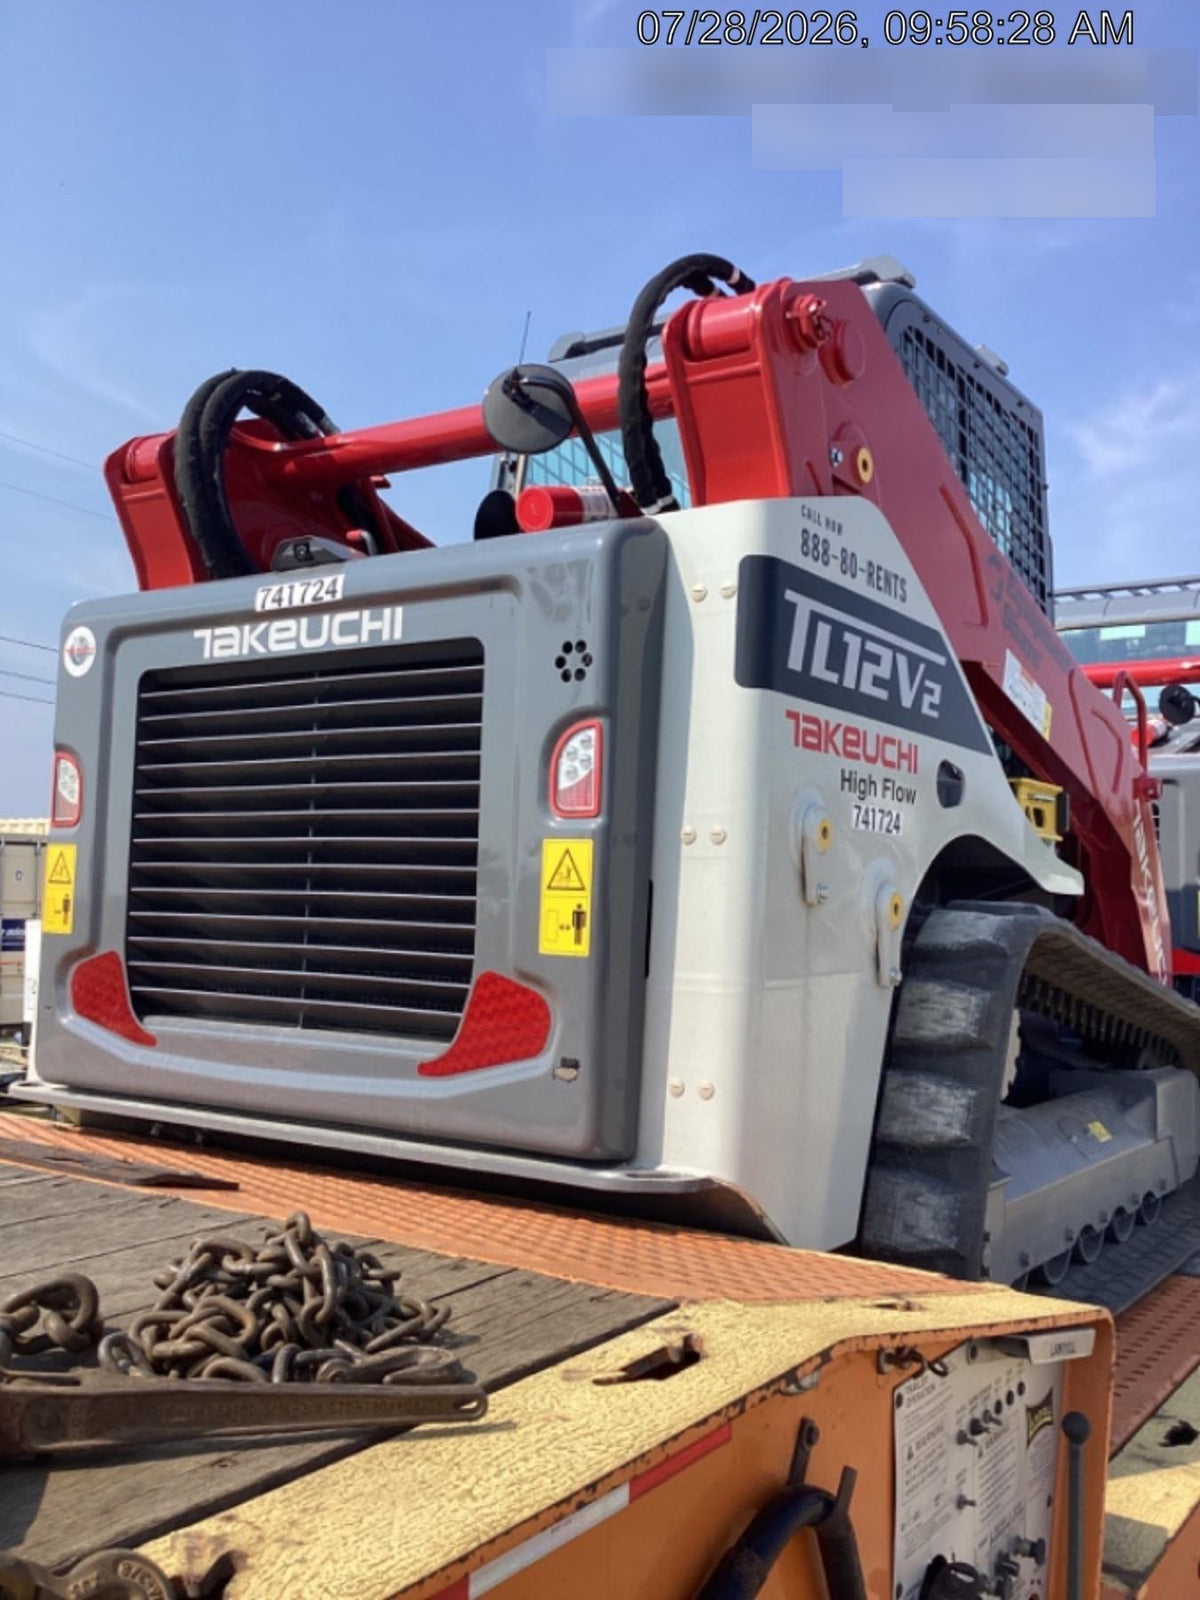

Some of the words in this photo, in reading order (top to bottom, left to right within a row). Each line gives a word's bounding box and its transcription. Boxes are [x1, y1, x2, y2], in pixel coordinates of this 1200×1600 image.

[801, 504, 822, 527] CALL
[801, 528, 908, 603] 888-80-RENTS
[260, 577, 338, 610] 741724
[193, 606, 403, 659] TAKEUCHI
[785, 709, 918, 775] TAKEUCHI
[840, 768, 877, 801] High
[881, 777, 917, 805] Flow
[854, 805, 901, 834] 741724
